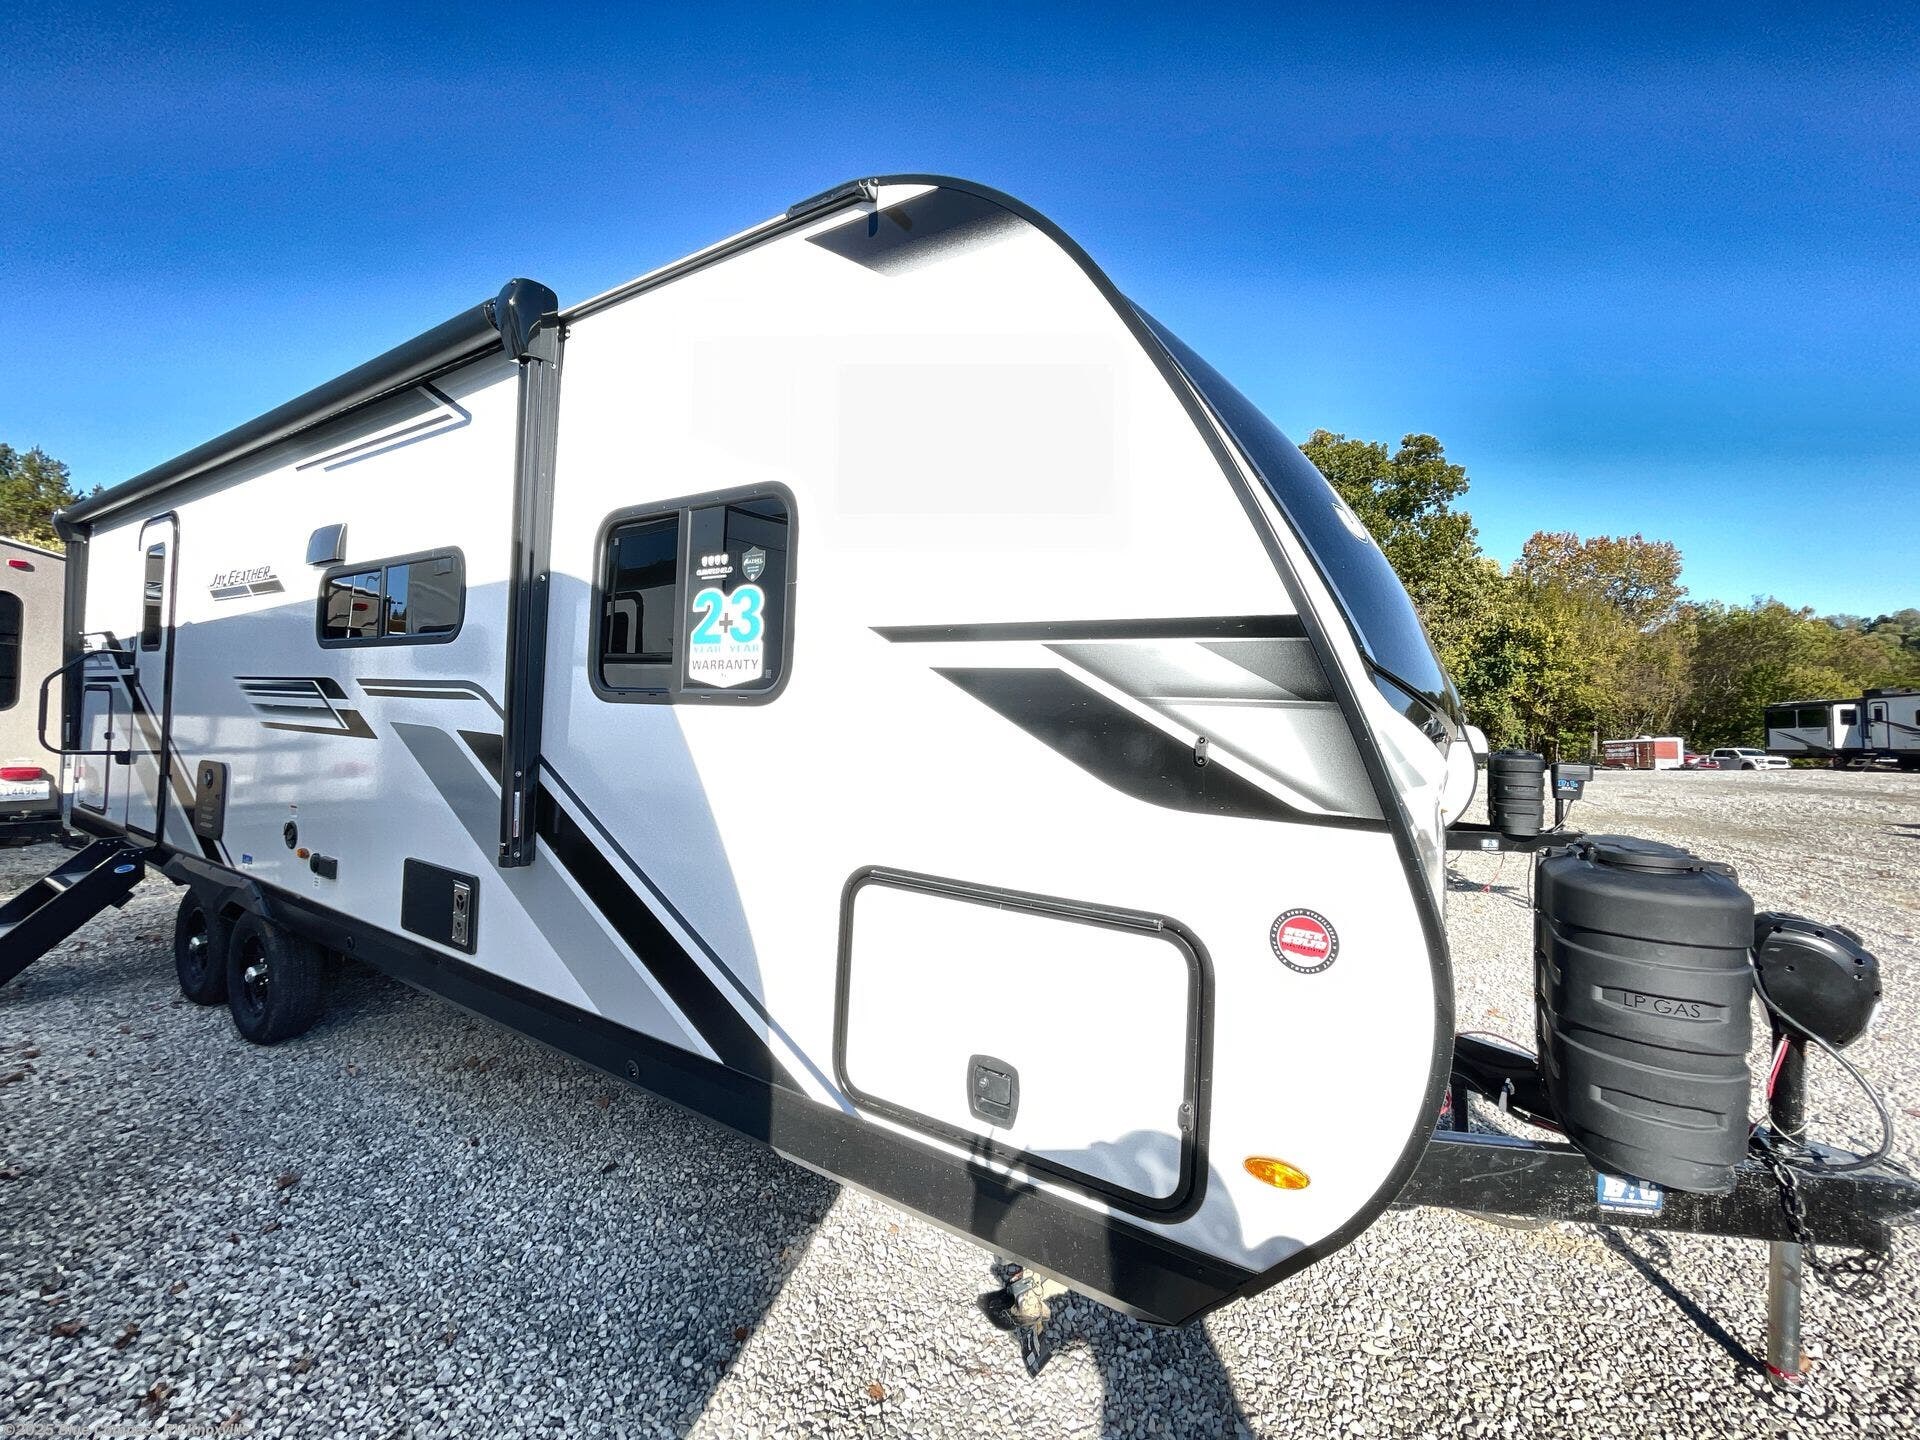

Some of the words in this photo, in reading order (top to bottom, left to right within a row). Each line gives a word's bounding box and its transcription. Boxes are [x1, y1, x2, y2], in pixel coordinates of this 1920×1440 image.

[228, 565, 271, 585] FEATHER
[692, 658, 759, 671] WARRANTY
[1623, 992, 1646, 1008] LP
[1654, 999, 1701, 1018] GAS
